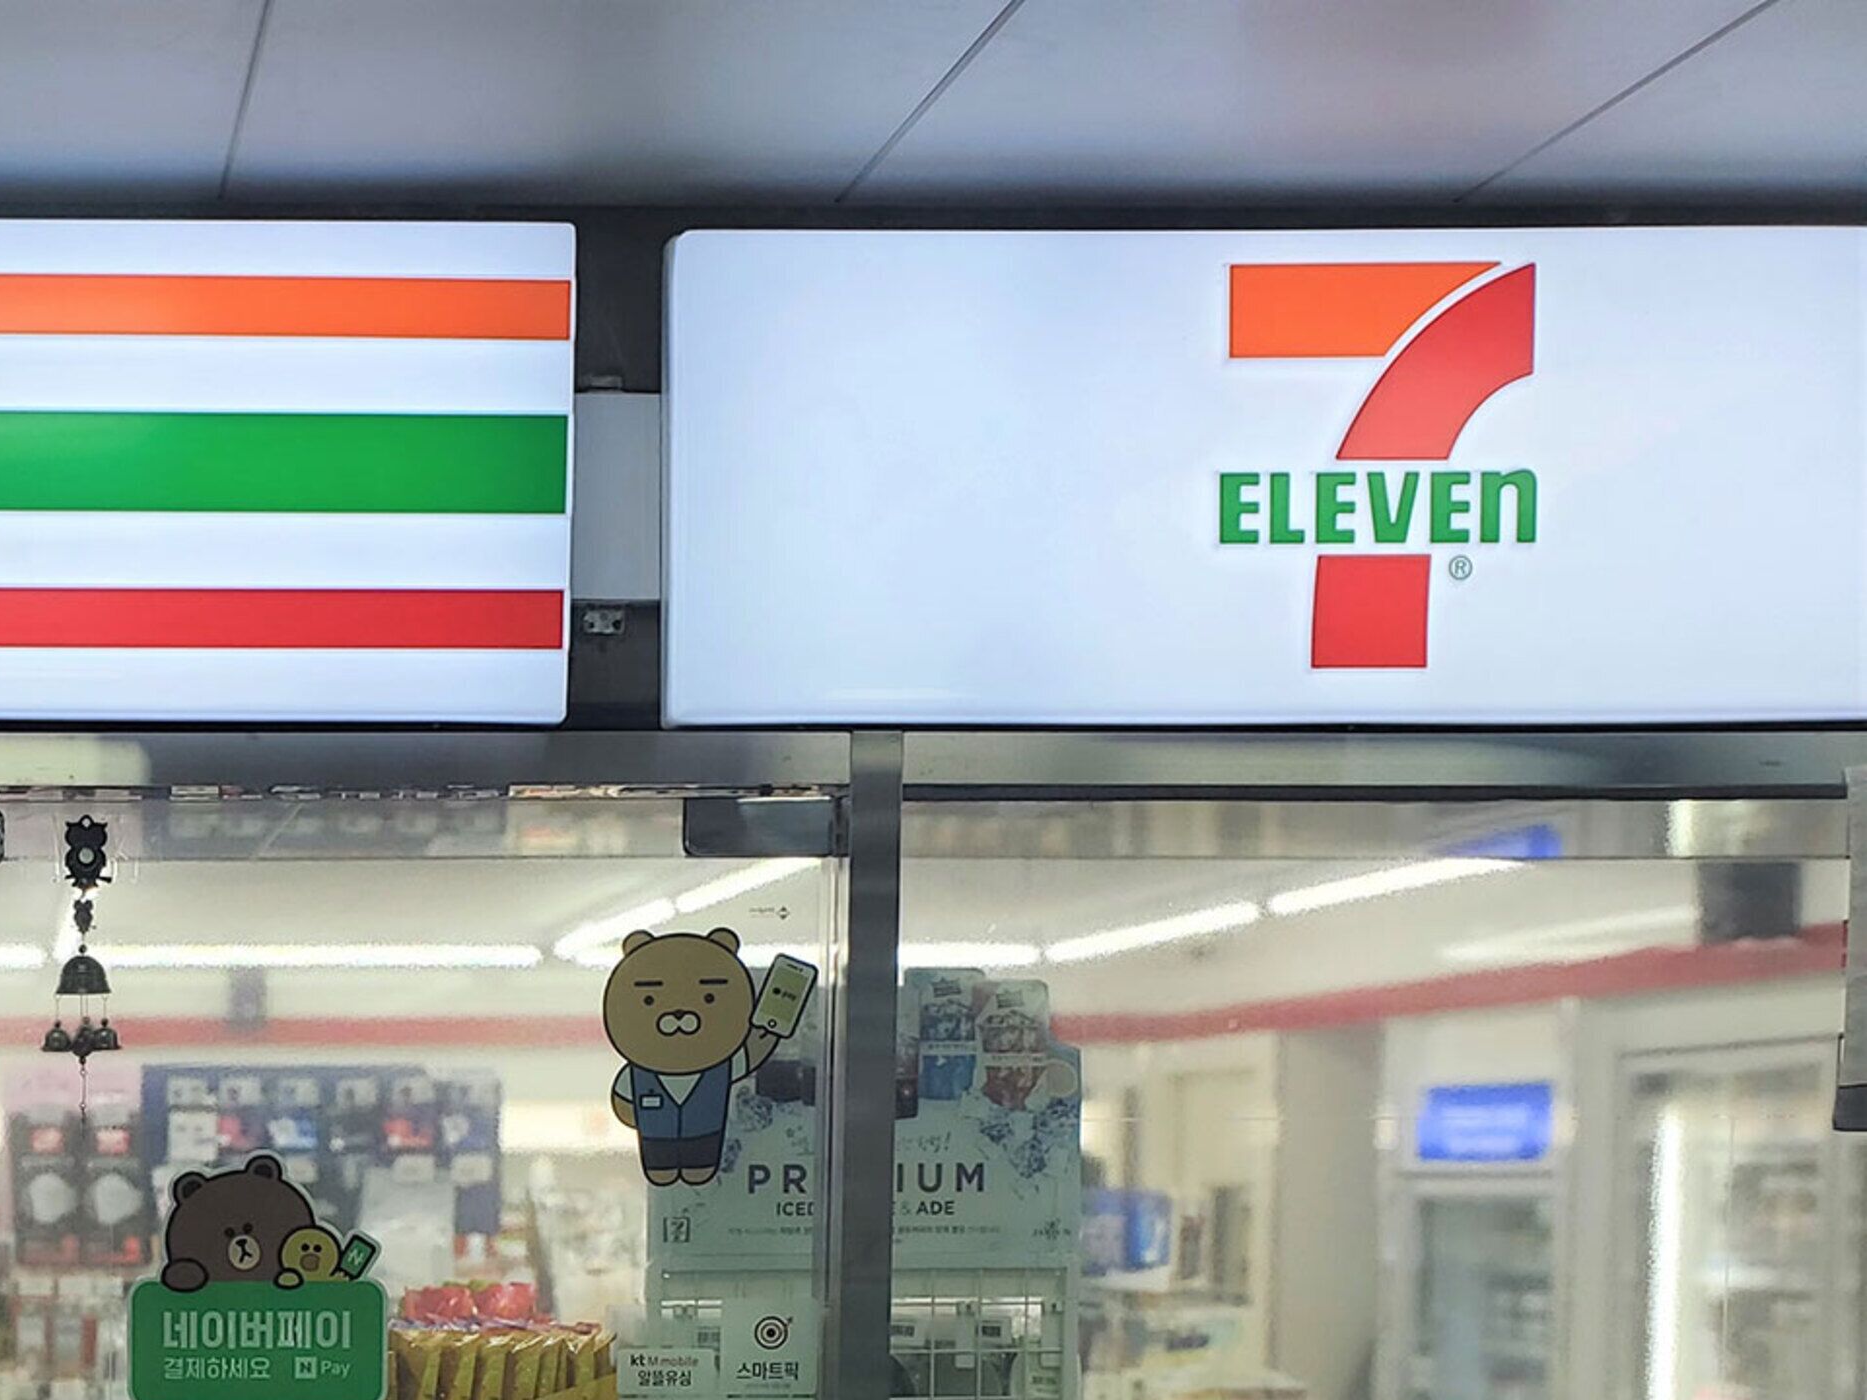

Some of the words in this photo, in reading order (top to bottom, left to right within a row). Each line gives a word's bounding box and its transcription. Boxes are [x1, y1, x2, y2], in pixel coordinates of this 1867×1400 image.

[1228, 261, 1536, 668] 7
[748, 1162, 985, 1194] PRIUM
[916, 1201, 956, 1216] ADE
[162, 1310, 352, 1350] 네이버페이
[164, 1356, 272, 1380] 결제하세요
[735, 1361, 800, 1380] 스마트픽
